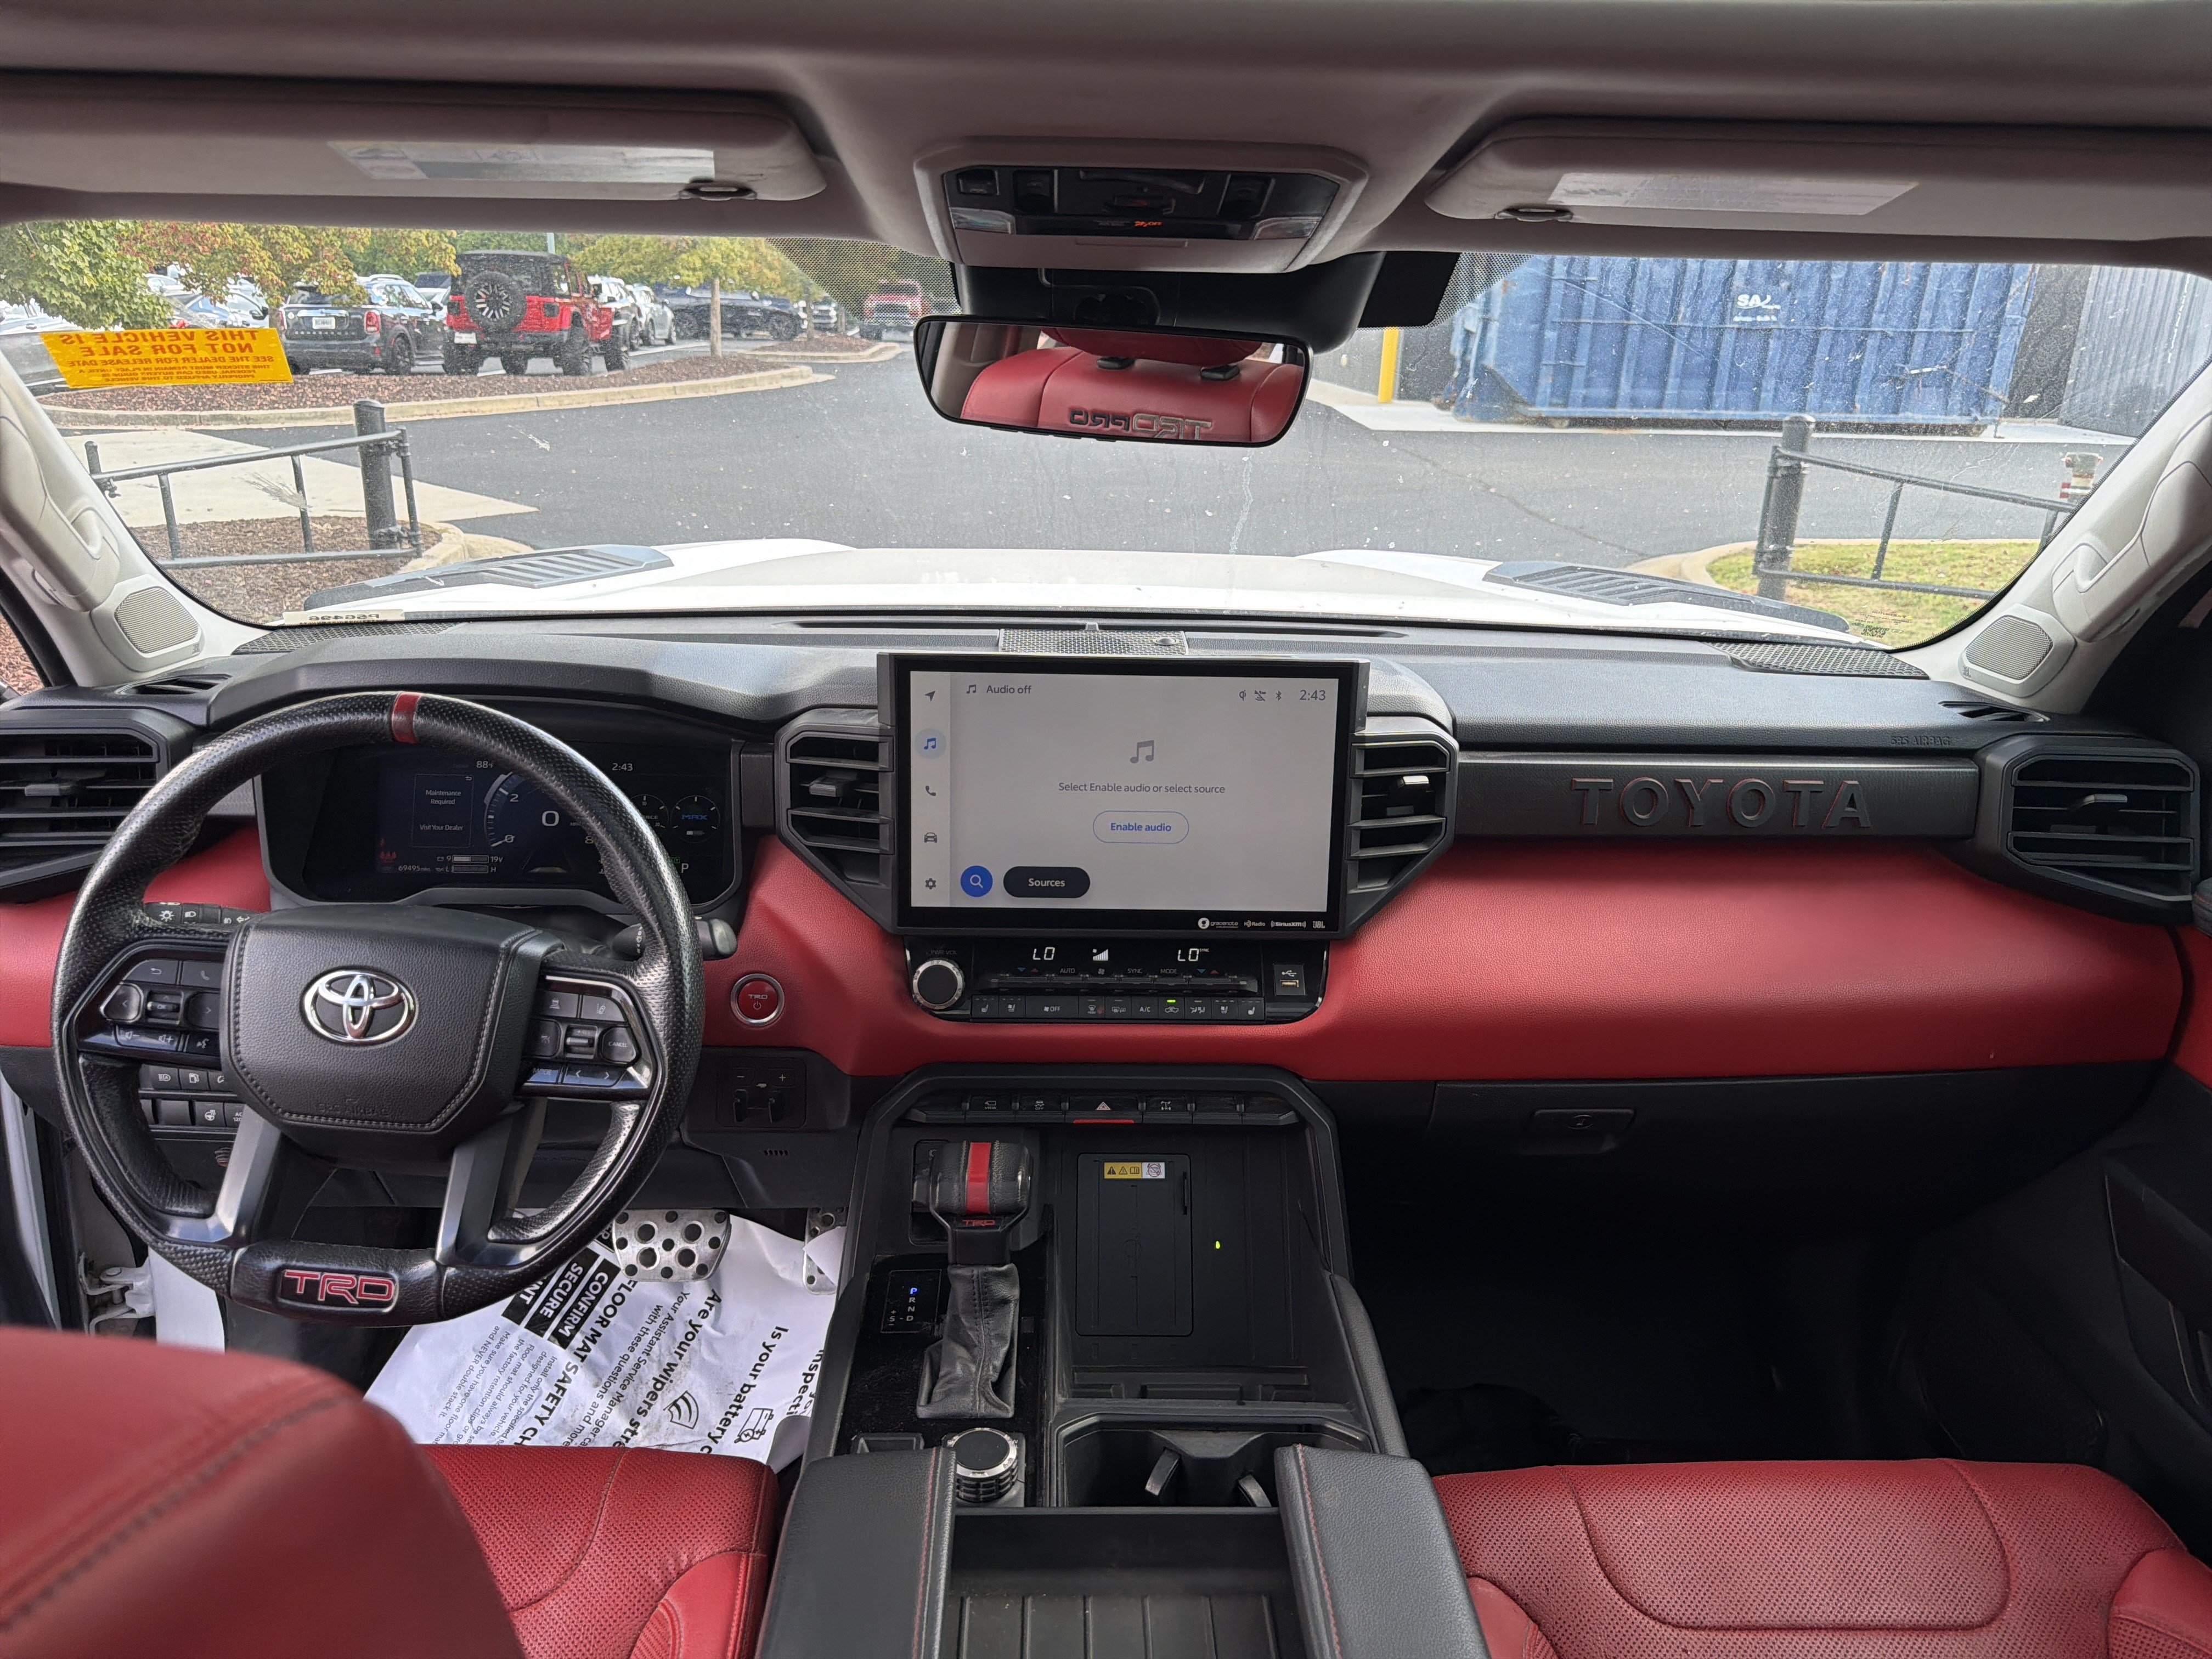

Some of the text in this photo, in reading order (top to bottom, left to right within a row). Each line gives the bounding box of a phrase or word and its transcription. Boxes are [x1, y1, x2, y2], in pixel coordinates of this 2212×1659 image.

[986, 685, 1032, 695] Audio off
[1299, 689, 1326, 701] 2:43
[612, 763, 633, 771] 2:43
[509, 793, 519, 802] 2
[1058, 782, 1087, 792] Select
[1090, 783, 1122, 792] Enable
[1124, 783, 1150, 793] audio
[1164, 784, 1192, 793] select
[1194, 786, 1226, 794] source
[1571, 776, 1872, 830] TOYOTA
[541, 810, 560, 827] 0
[1110, 822, 1171, 832] Enable audio
[584, 836, 594, 844] 8
[681, 862, 689, 874] P
[1028, 878, 1065, 888] Sources
[1312, 920, 1325, 929] JBL
[284, 1268, 394, 1305] TRD
[539, 1262, 584, 1319] SECURE
[558, 1272, 609, 1338] CONFIRM
[670, 1291, 691, 1314] Your
[697, 1288, 723, 1320] Are
[489, 1325, 501, 1340] and
[494, 1330, 511, 1351] Make
[641, 1312, 674, 1357] Assistant
[674, 1319, 703, 1361] your
[771, 1325, 789, 1340] Is
[472, 1339, 493, 1365] NEVER
[514, 1338, 526, 1352] the
[573, 1327, 603, 1363] MAT
[484, 1349, 497, 1365] sure
[496, 1348, 519, 1376] factory
[524, 1351, 548, 1384] designed
[748, 1341, 776, 1380] your
[455, 1364, 475, 1392] double
[475, 1364, 488, 1380] you
[562, 1304, 664, 1447] with these questions and more
[619, 1356, 647, 1392] Service
[465, 1379, 478, 1398] have
[472, 1343, 535, 1436] Floor mat should always be
[479, 1374, 501, 1409] retention
[501, 1355, 558, 1439] Install only the specified
[518, 1383, 531, 1396] for
[534, 1361, 579, 1427] SAFETY
[636, 1362, 679, 1418] wipers
[443, 1390, 459, 1412] stack
[455, 1396, 468, 1414] one
[508, 1393, 522, 1412] your
[444, 1412, 460, 1432] floor
[467, 1408, 481, 1427] clips
[589, 1391, 625, 1438] Manager
[707, 1383, 757, 1445] battery
[463, 1425, 471, 1435] or
